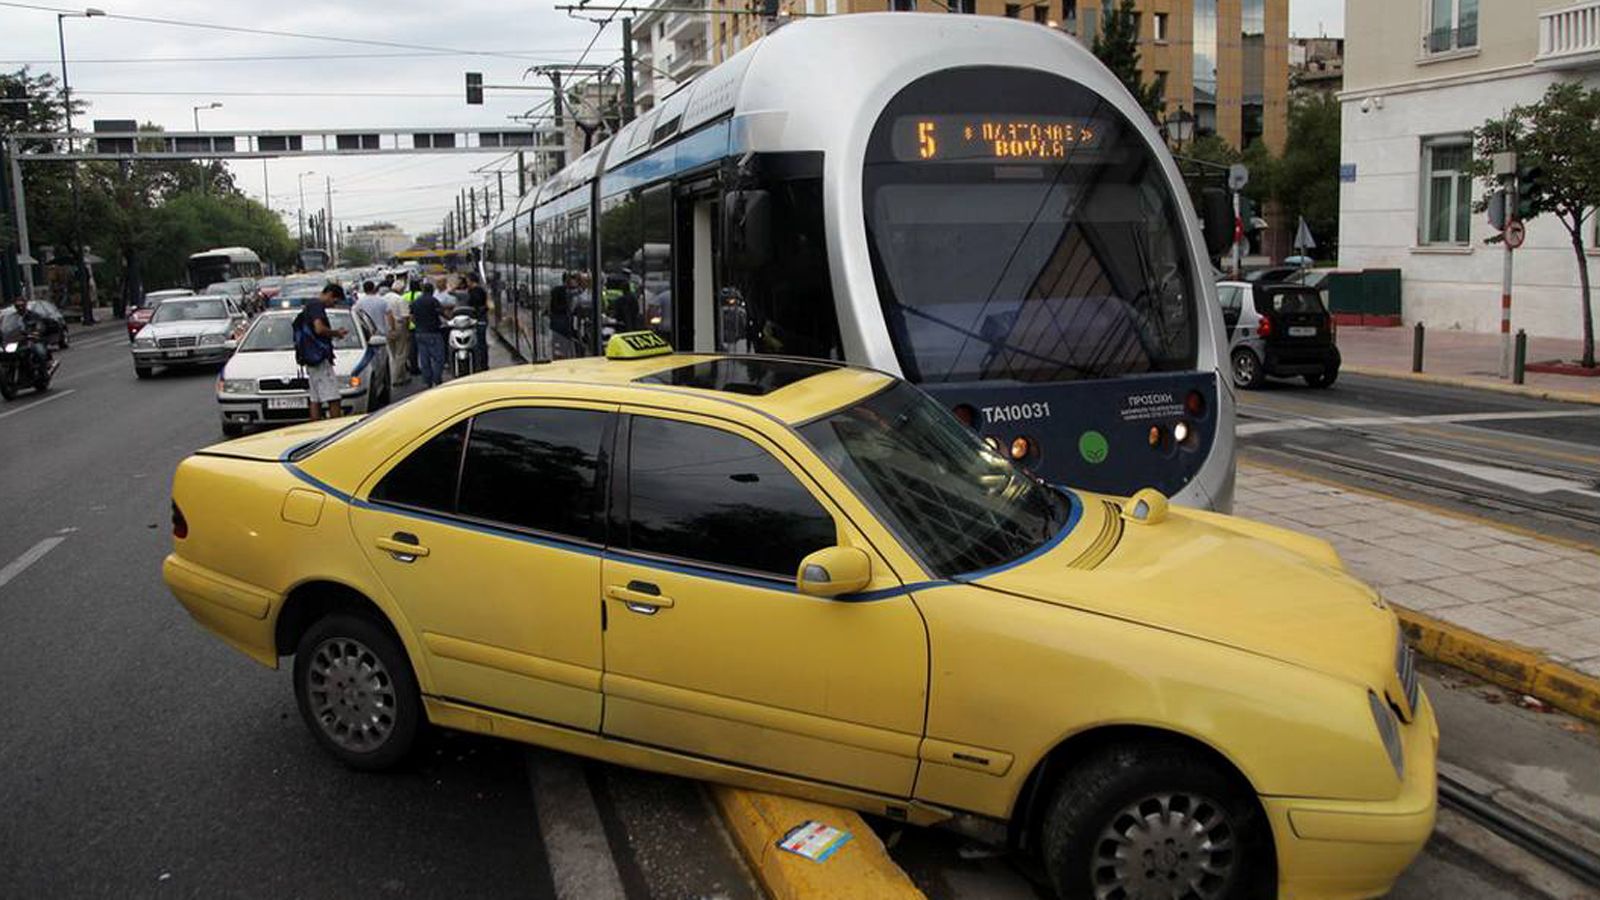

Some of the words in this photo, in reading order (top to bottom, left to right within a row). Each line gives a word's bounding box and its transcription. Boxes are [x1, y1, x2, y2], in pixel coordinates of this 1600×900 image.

[918, 121, 937, 159] 5
[625, 332, 665, 350] TAXI
[1128, 393, 1173, 407] ΠΡΟΣΟΧΗ
[981, 401, 1051, 423] TA10031
